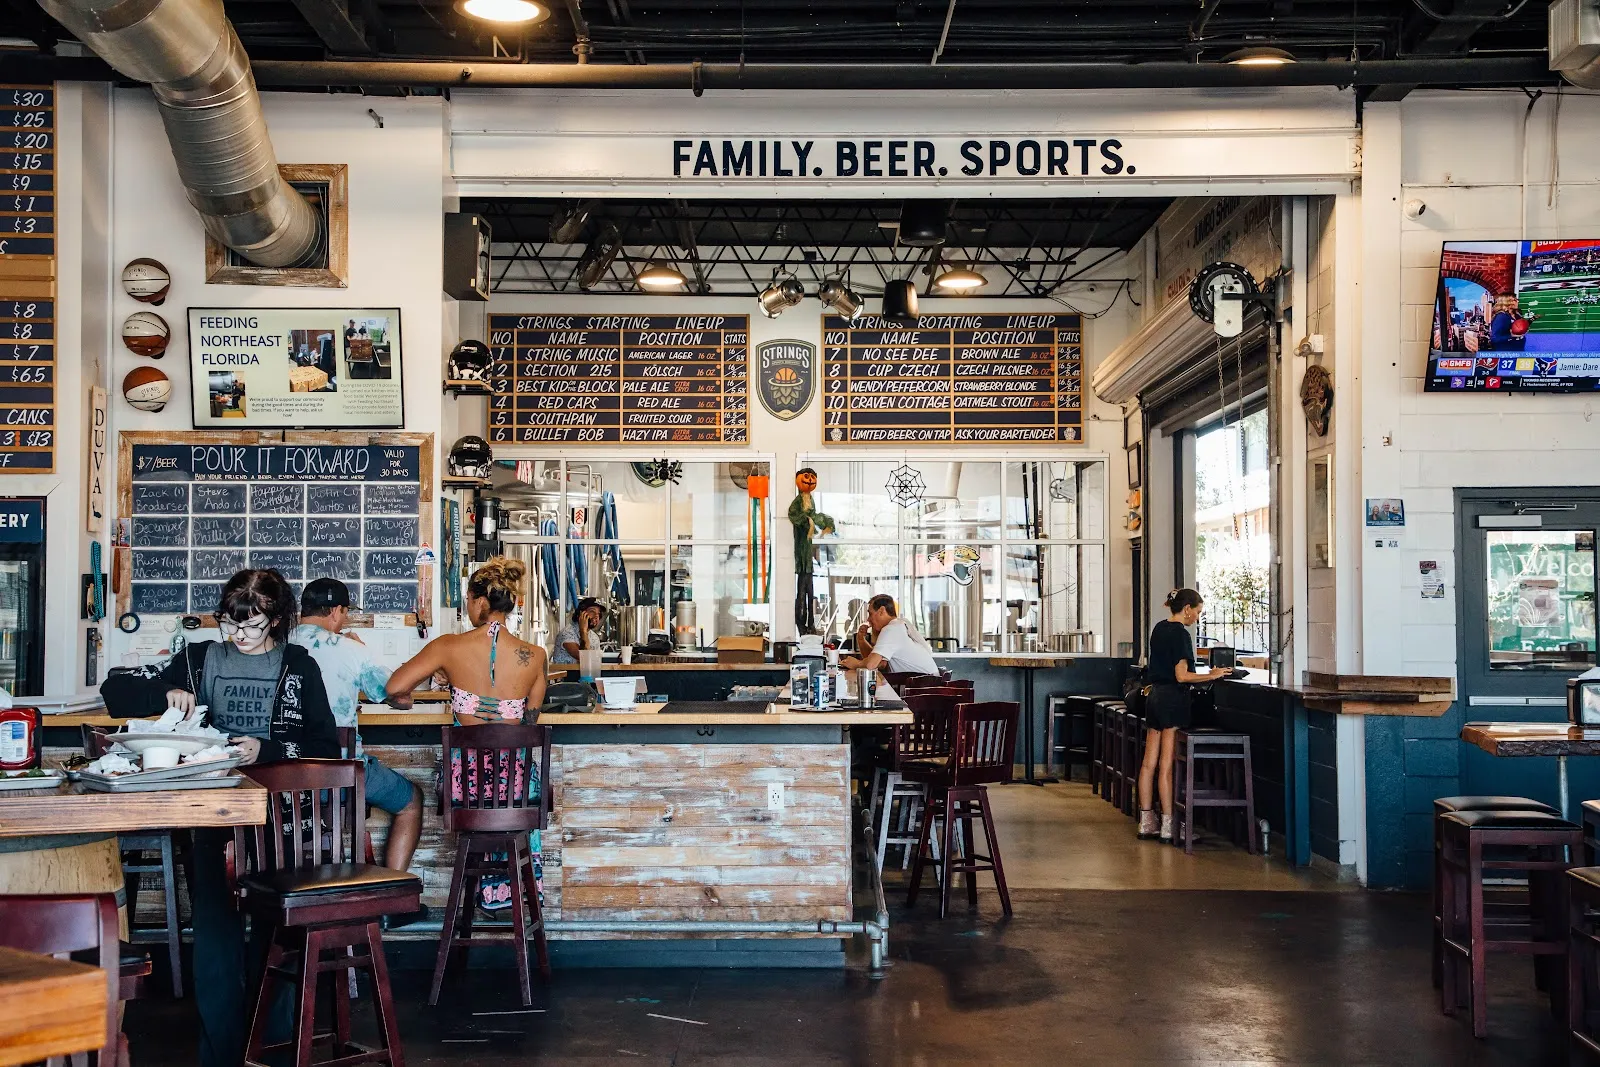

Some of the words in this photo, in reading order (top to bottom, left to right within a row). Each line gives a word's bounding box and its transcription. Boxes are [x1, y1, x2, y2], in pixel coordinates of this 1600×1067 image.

[13, 90, 44, 106] $30
[13, 111, 45, 128] $25
[14, 132, 48, 150] $20
[14, 153, 42, 170] $15
[673, 140, 823, 177] FAMILY.
[836, 140, 948, 177] BEER.
[960, 139, 1137, 176] SPORTS.
[12, 174, 30, 191] $9
[200, 316, 258, 329] FEEDING
[517, 316, 574, 329] STRINGS
[586, 316, 650, 329] STARTING
[676, 316, 724, 329] LINEUP
[918, 316, 982, 329] ROTATING
[1007, 316, 1056, 329] LINEUP
[13, 322, 32, 340] $8
[1058, 332, 1080, 342] STATS
[201, 335, 282, 347] NORTHEAST
[492, 332, 513, 344] NO.
[548, 332, 588, 344] NAME
[638, 332, 703, 345] POSITION
[724, 334, 746, 344] STATS
[825, 332, 847, 344] NO.
[880, 332, 920, 344] NAME
[972, 332, 1036, 344] POSITION
[202, 353, 260, 366] FLORIDA
[497, 348, 505, 361] 1
[525, 348, 572, 361] STRING
[576, 348, 618, 361] MUSIC
[763, 346, 809, 368] STRINGS
[830, 348, 840, 361] 7
[862, 348, 881, 360] NO
[884, 348, 909, 360] SEE
[913, 348, 939, 360] DEE
[961, 349, 999, 359] BROWN
[1001, 349, 1021, 359] ALE
[524, 364, 578, 376] SECTION
[590, 364, 612, 376] 215
[868, 364, 893, 376] CUP
[899, 364, 940, 376] CZECH
[957, 364, 990, 376] CZECH
[992, 364, 1032, 376] PILSNER
[1502, 360, 1513, 368] 37
[12, 366, 46, 383] $6.5
[497, 364, 507, 377] 2
[643, 364, 683, 377] KÖLSCH
[830, 364, 840, 377] 8
[496, 380, 507, 392] 3
[517, 381, 547, 392] BEST
[548, 381, 568, 392] KID
[578, 381, 617, 392] BLOCK
[622, 382, 647, 392] PALE
[650, 382, 670, 392] ALE
[831, 380, 840, 393] 9
[851, 381, 887, 392] WENDY
[888, 381, 951, 392] PEFFERCORN
[954, 382, 1005, 391] STRAWBERRY
[1005, 382, 1038, 391] BLONDE
[496, 396, 506, 409] 4
[538, 397, 563, 409] RED
[567, 397, 599, 409] CAPS
[637, 397, 658, 408] RED
[661, 397, 681, 408] ALE
[828, 396, 845, 409] 10
[851, 396, 895, 409] CRAVEN
[898, 396, 950, 409] COTTAGE
[954, 397, 998, 407] OATMEAL
[1001, 397, 1034, 407] STOUT
[6, 408, 50, 425] CANS
[496, 412, 506, 425] 5
[529, 413, 597, 425] SOUTHPAW
[629, 415, 665, 423] FRUITED
[668, 415, 692, 423] SOUR
[829, 412, 841, 425] 11
[27, 431, 51, 446] $13
[496, 428, 505, 440] 6
[524, 428, 571, 440] BULLET
[578, 428, 604, 440] BOB
[622, 430, 650, 440] HAZY
[652, 430, 668, 440] IPA
[852, 430, 886, 440] LIMITED
[887, 430, 918, 440] BEERS
[918, 430, 933, 440] ON
[934, 430, 951, 440] TAP
[955, 429, 974, 439] ASK
[975, 429, 1000, 439] YOUR
[1000, 429, 1055, 439] BARTENDER
[191, 446, 248, 473] POUR
[258, 448, 275, 473] IT
[284, 448, 370, 474] FORWARD
[384, 450, 404, 458] VALID
[380, 469, 390, 477] 30
[392, 469, 408, 477] DAYS
[139, 488, 169, 498] Zack
[311, 552, 342, 564] Captain
[372, 554, 398, 564] Mike
[224, 685, 272, 698] FAMILY.
[228, 701, 266, 713] BEER.
